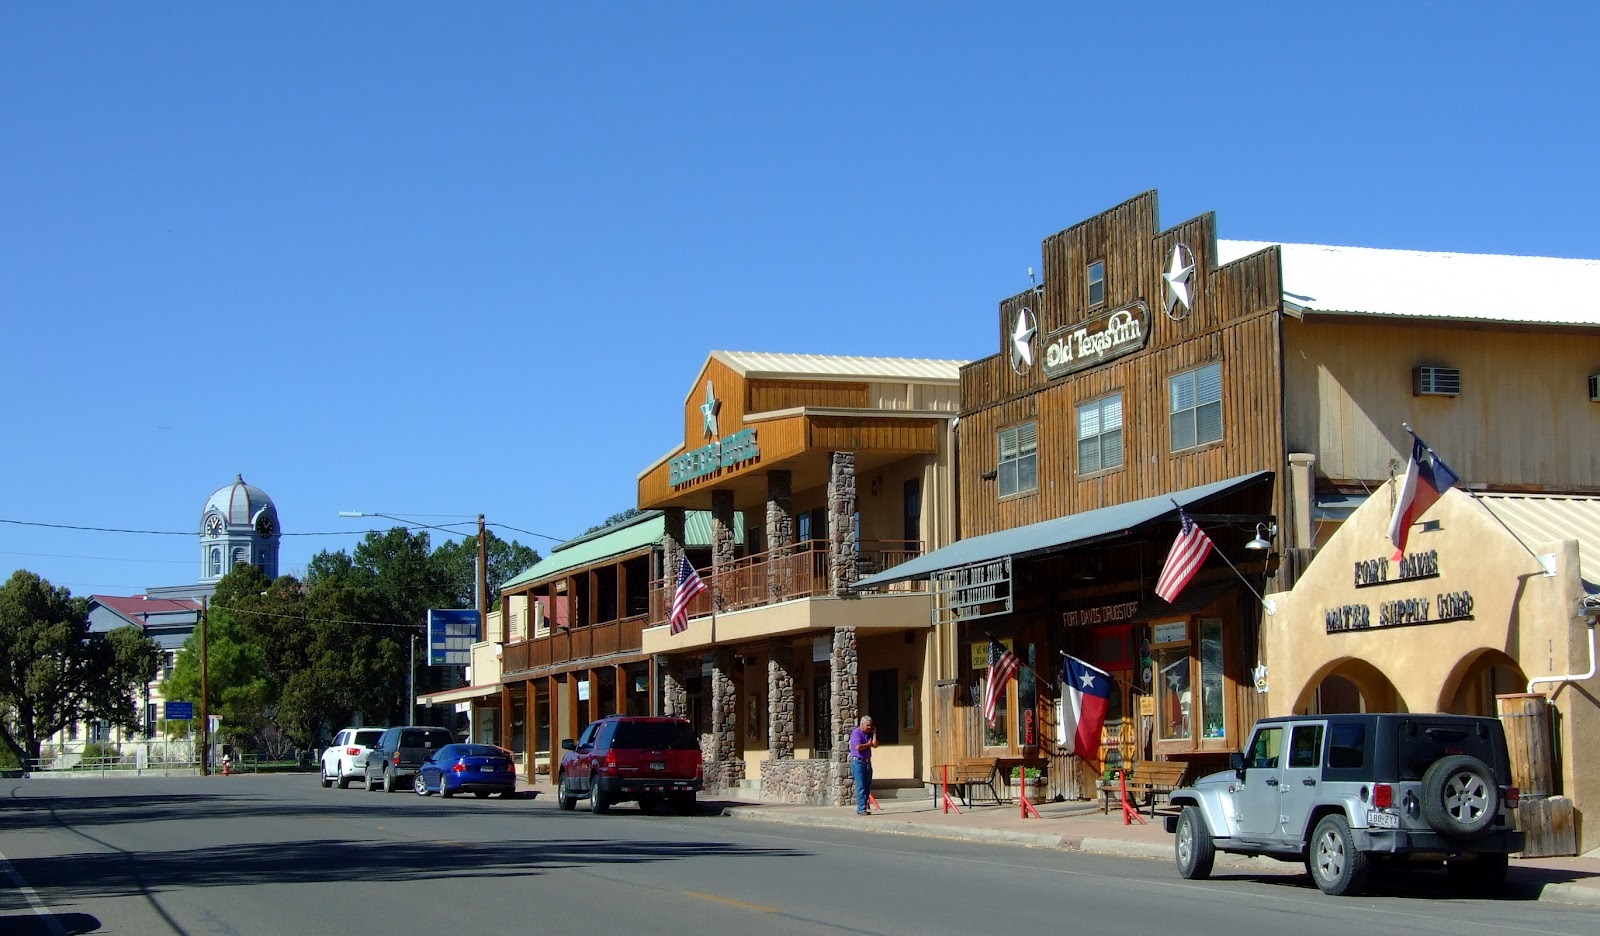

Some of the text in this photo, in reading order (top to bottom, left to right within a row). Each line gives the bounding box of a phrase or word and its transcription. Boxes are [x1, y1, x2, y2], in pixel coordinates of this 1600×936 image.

[1047, 310, 1142, 367] Old Texas Inn
[1354, 549, 1438, 585] FORT DAVIS
[1063, 611, 1079, 627] FORT
[1080, 607, 1101, 626] DAVIS
[1325, 590, 1474, 631] WATER SUPPLY CORP
[1024, 709, 1034, 745] OPEN
